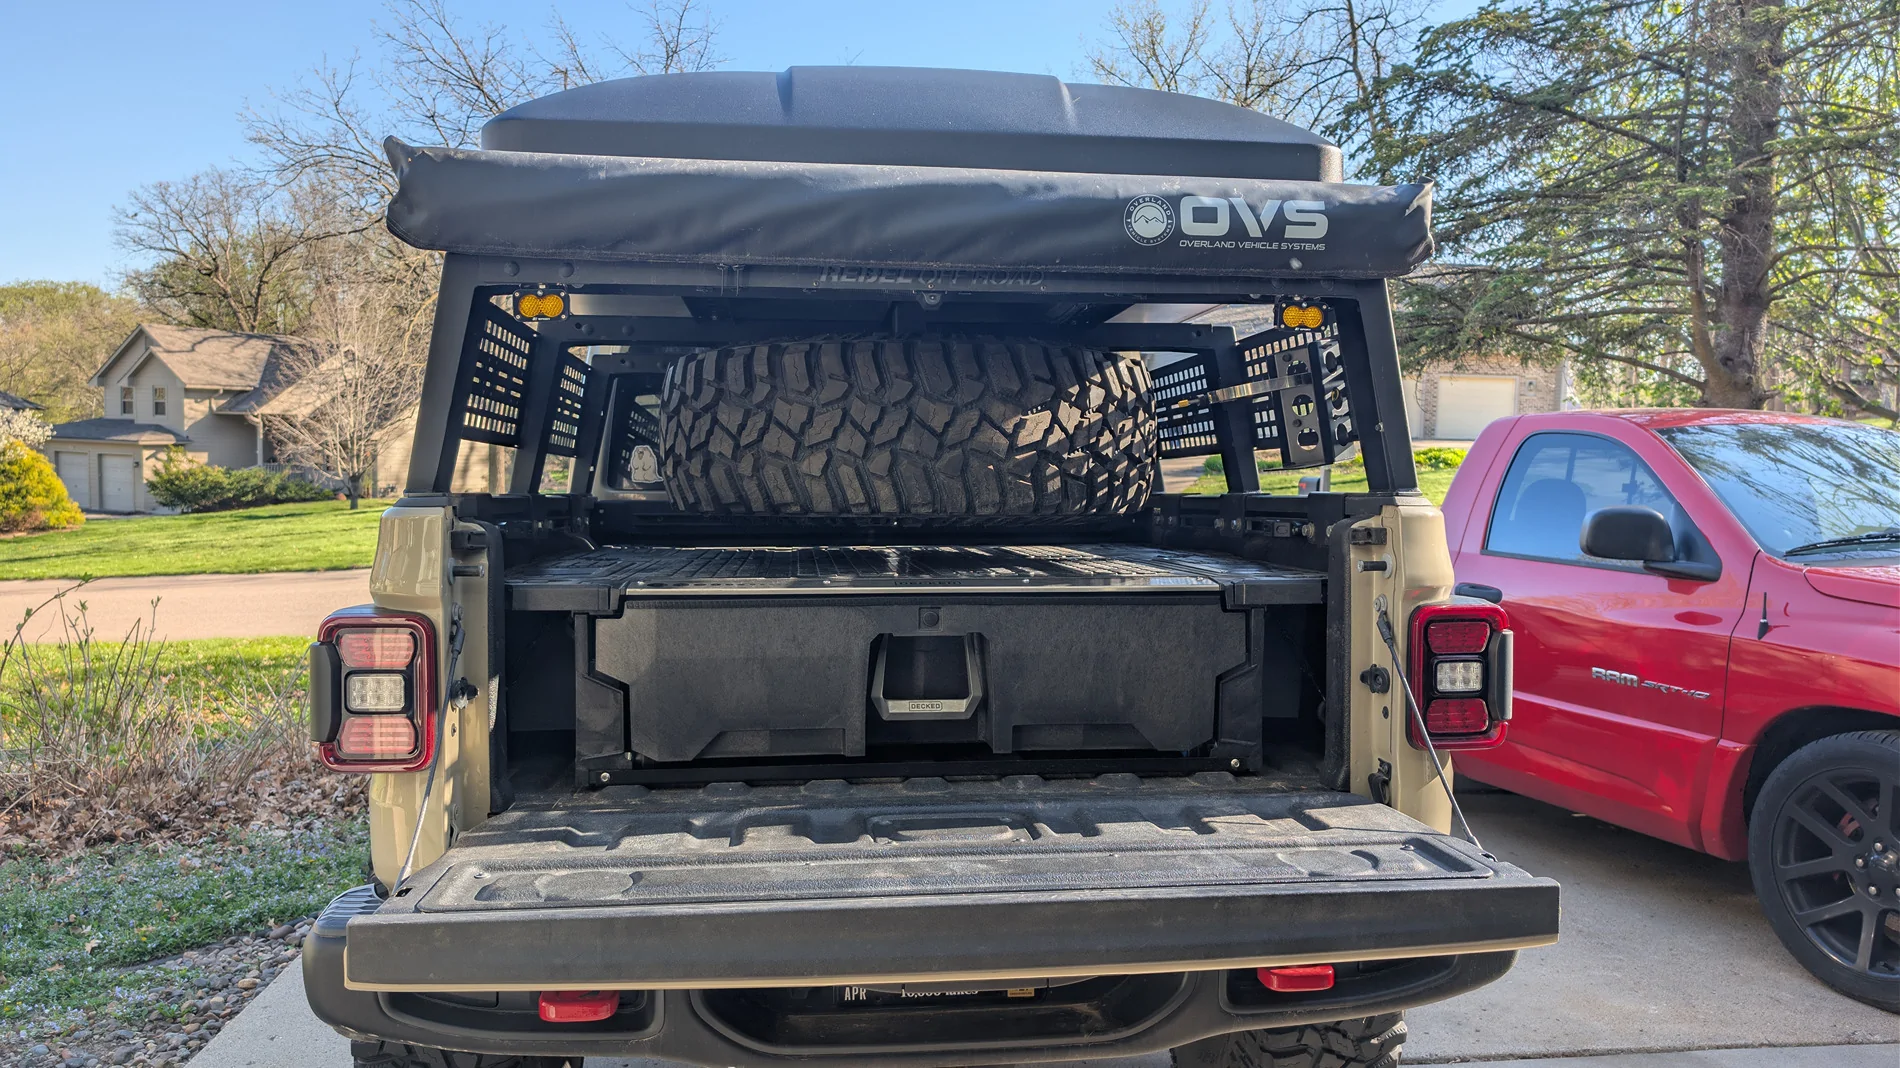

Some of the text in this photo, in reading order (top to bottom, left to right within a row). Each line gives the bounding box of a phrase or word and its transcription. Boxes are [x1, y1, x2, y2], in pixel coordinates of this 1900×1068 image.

[1129, 196, 1171, 216] OVERLAND
[1180, 195, 1329, 239] OVS
[1127, 223, 1147, 243] VEHICLE
[1179, 239, 1326, 251] OVERLAND VEHICLE SYSTEMS
[820, 266, 1045, 286] REBEL OFF ROAD
[1592, 667, 1711, 699] RAM SRT-10
[844, 986, 867, 1001] APR
